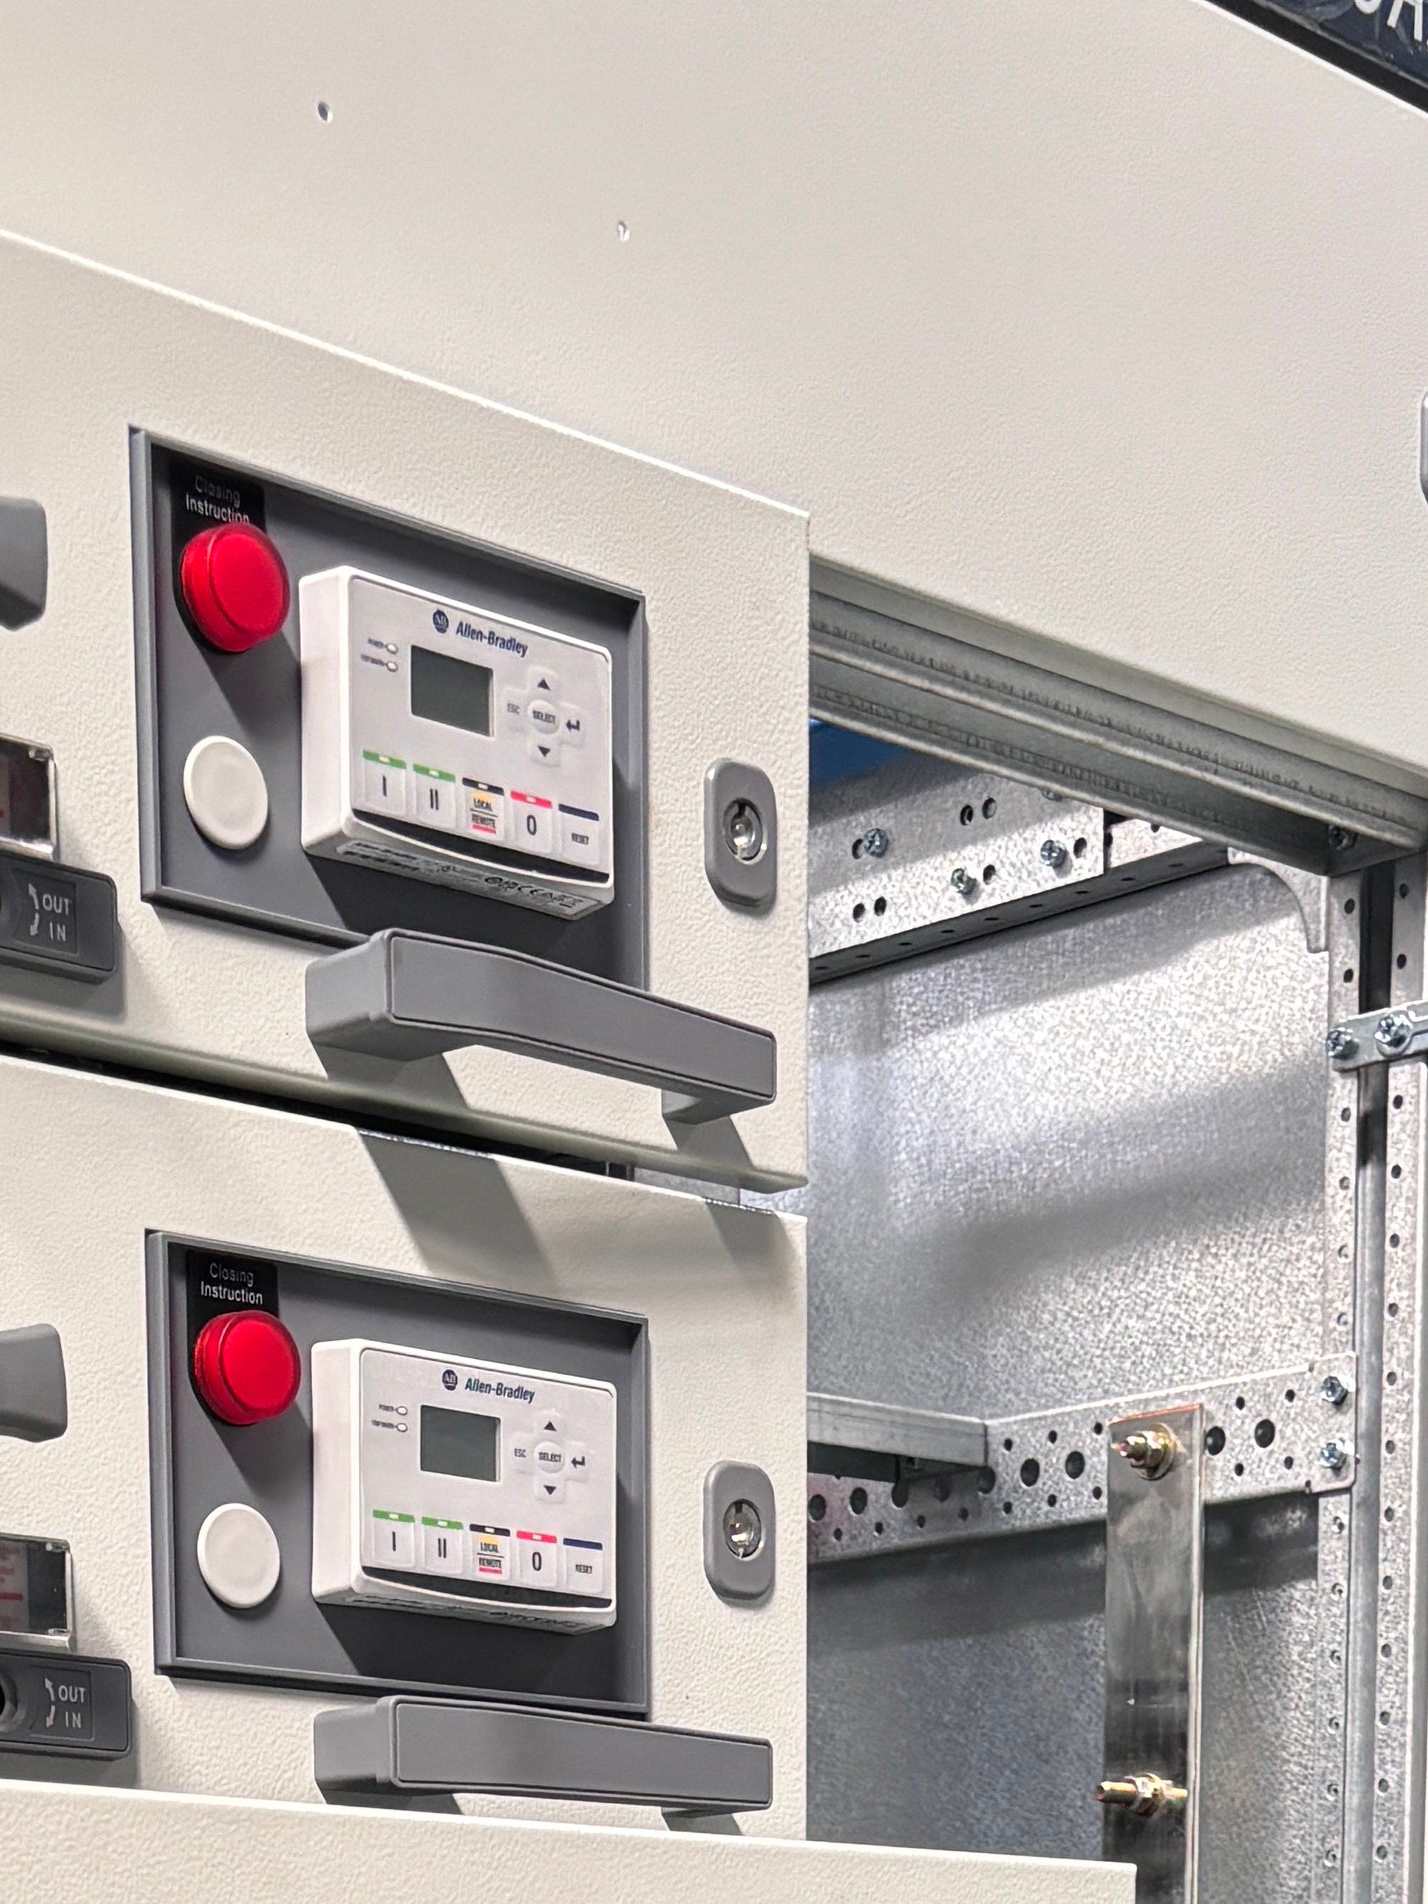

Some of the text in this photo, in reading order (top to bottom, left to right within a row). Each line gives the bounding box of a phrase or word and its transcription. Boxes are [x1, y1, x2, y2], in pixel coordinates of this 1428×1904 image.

[194, 475, 241, 508] Closing
[185, 494, 250, 524] Instruction
[456, 621, 529, 659] Allen-Bradley
[532, 709, 556, 727] SELECT
[473, 798, 493, 812] LOCAL
[42, 895, 71, 916] OUT
[49, 920, 68, 942] IN
[208, 1262, 255, 1287] Closing
[200, 1281, 263, 1306] Instruction
[465, 1377, 536, 1404] Allen-Bradley
[514, 1447, 527, 1459] ESC
[538, 1450, 562, 1465] SELECT
[480, 1541, 500, 1553] LOCAL
[575, 1563, 593, 1576] RESET
[58, 1686, 86, 1704] OUT
[64, 1710, 82, 1729] IN
